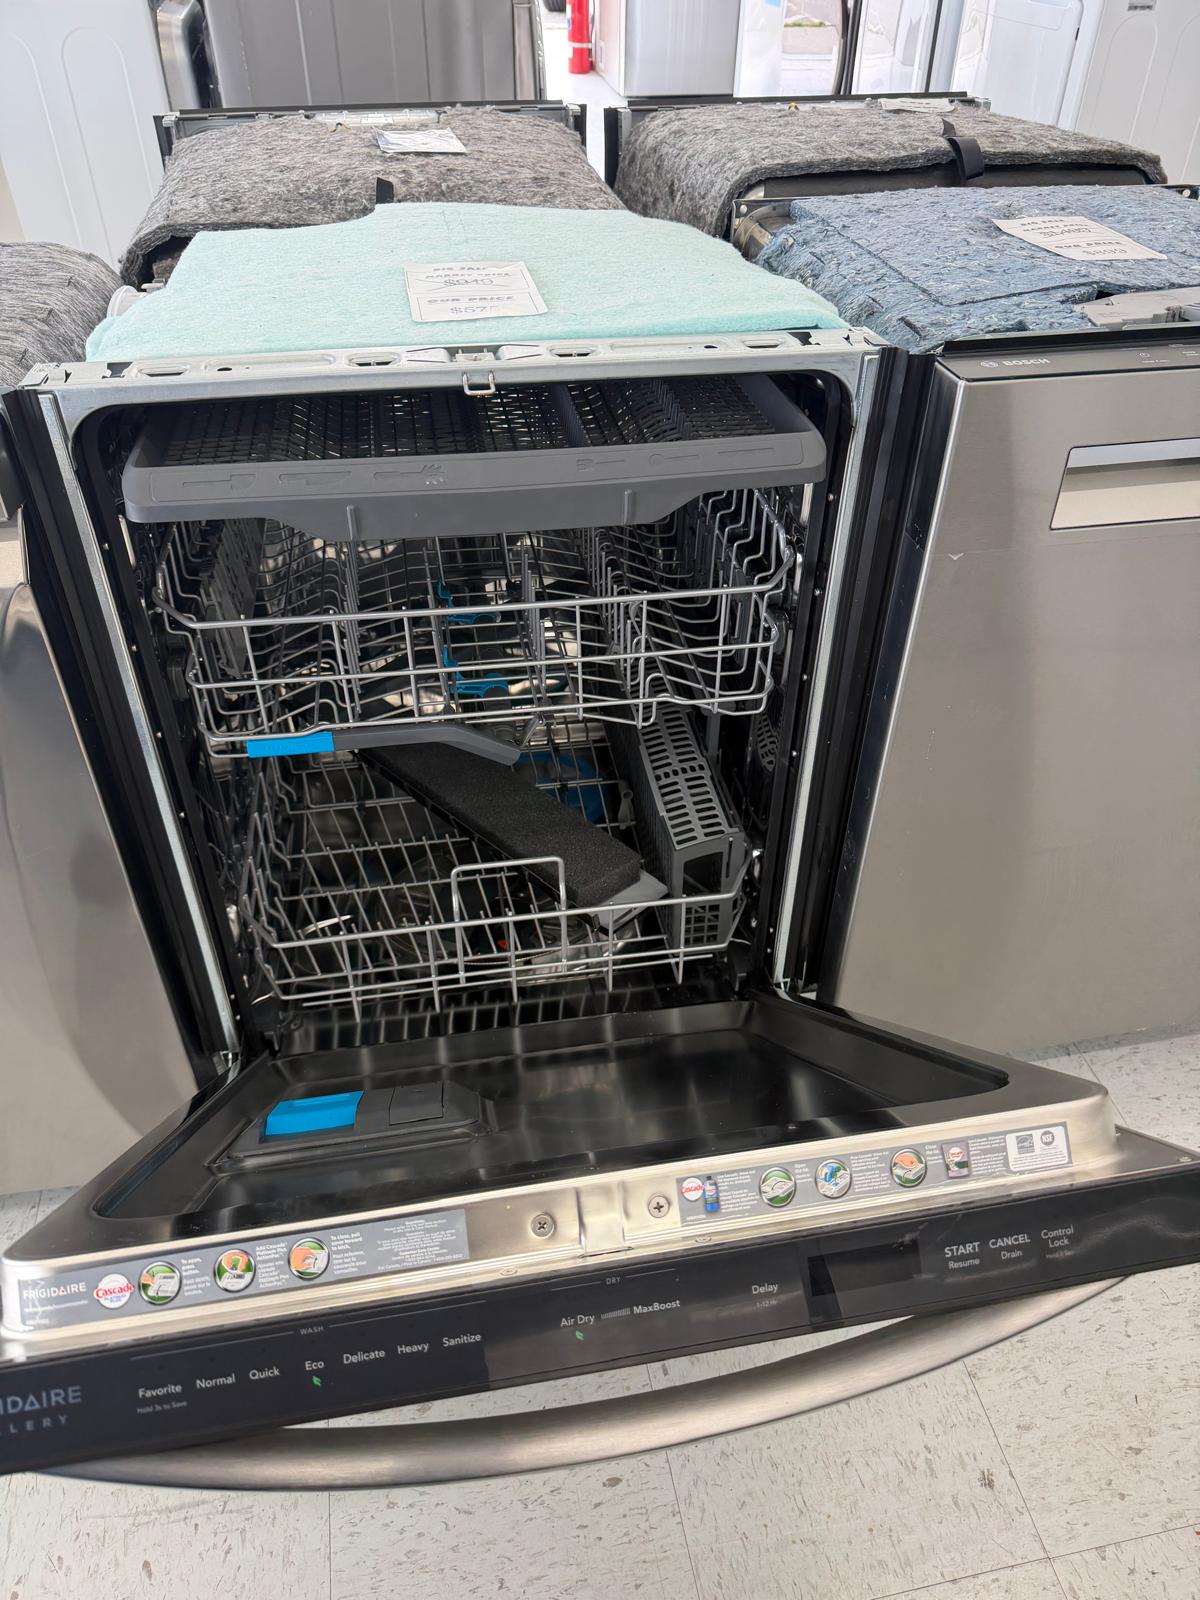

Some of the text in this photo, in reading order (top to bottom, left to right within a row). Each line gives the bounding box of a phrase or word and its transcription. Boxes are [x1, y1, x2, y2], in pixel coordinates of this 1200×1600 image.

[1002, 358, 1051, 367] BOSCH
[1041, 1133, 1054, 1143] NSF
[1041, 1225, 1074, 1239] Control
[944, 1234, 1031, 1257] START CANCEL
[1048, 1237, 1069, 1248] Lock
[948, 1250, 1023, 1269] Resume Drain
[605, 1276, 622, 1285] DRY
[23, 1282, 87, 1300] FRIGIDAIRE
[95, 1283, 136, 1299] Cascade
[752, 1283, 779, 1295] Delay
[633, 1299, 681, 1315] MaxBoost
[560, 1314, 595, 1327] Air Dry
[300, 1326, 324, 1335] WASH
[442, 1333, 482, 1347] Sanitize
[397, 1342, 430, 1355] Heavy
[343, 1350, 386, 1364] Delicate
[305, 1360, 325, 1371] Eco
[249, 1366, 281, 1380] Quick
[196, 1373, 236, 1389] Normal
[138, 1383, 183, 1399] Favorite
[137, 1406, 153, 1415] Hold
[171, 1401, 188, 1409] Save
[0, 1414, 68, 1436] LERY
